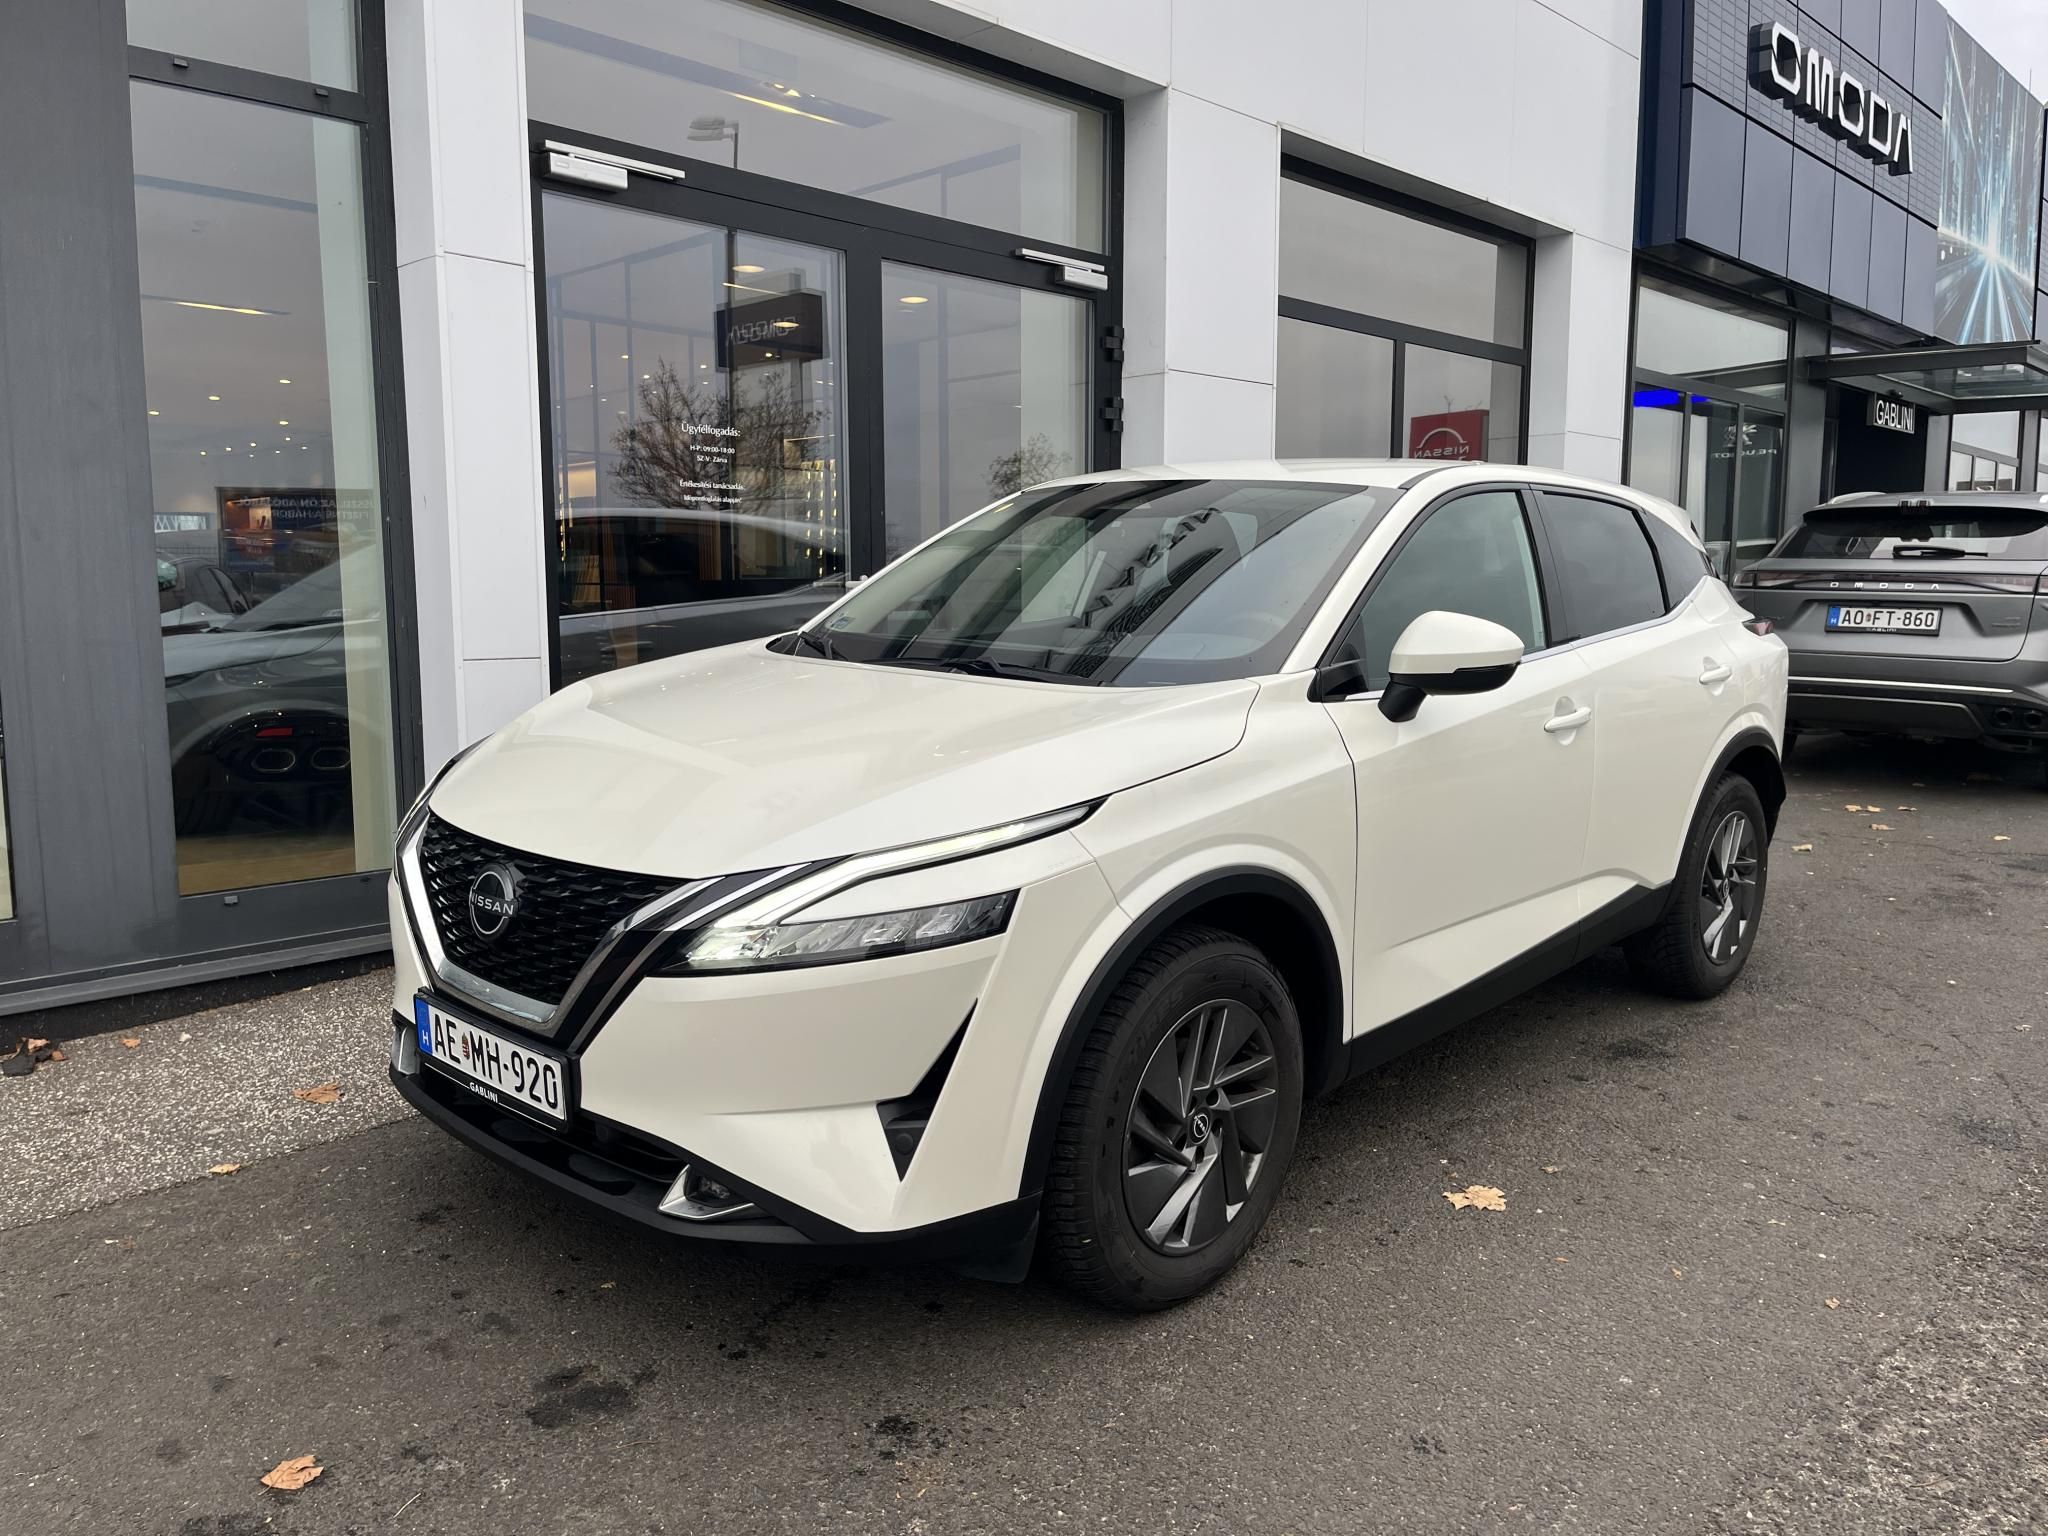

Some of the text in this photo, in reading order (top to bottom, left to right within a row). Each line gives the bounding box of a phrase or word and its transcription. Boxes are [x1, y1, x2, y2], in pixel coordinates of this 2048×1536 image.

[1768, 20, 1913, 174] OMODA
[1876, 400, 1913, 431] GABLINI
[681, 420, 741, 437] Ügyfélfogadás:
[703, 446, 735, 454] 09:00-18:00
[1830, 582, 1940, 590] OMODA
[1872, 611, 1935, 627] FT-860
[422, 1014, 557, 1109] H AE MH-920
[469, 1082, 499, 1103] GABLINI
